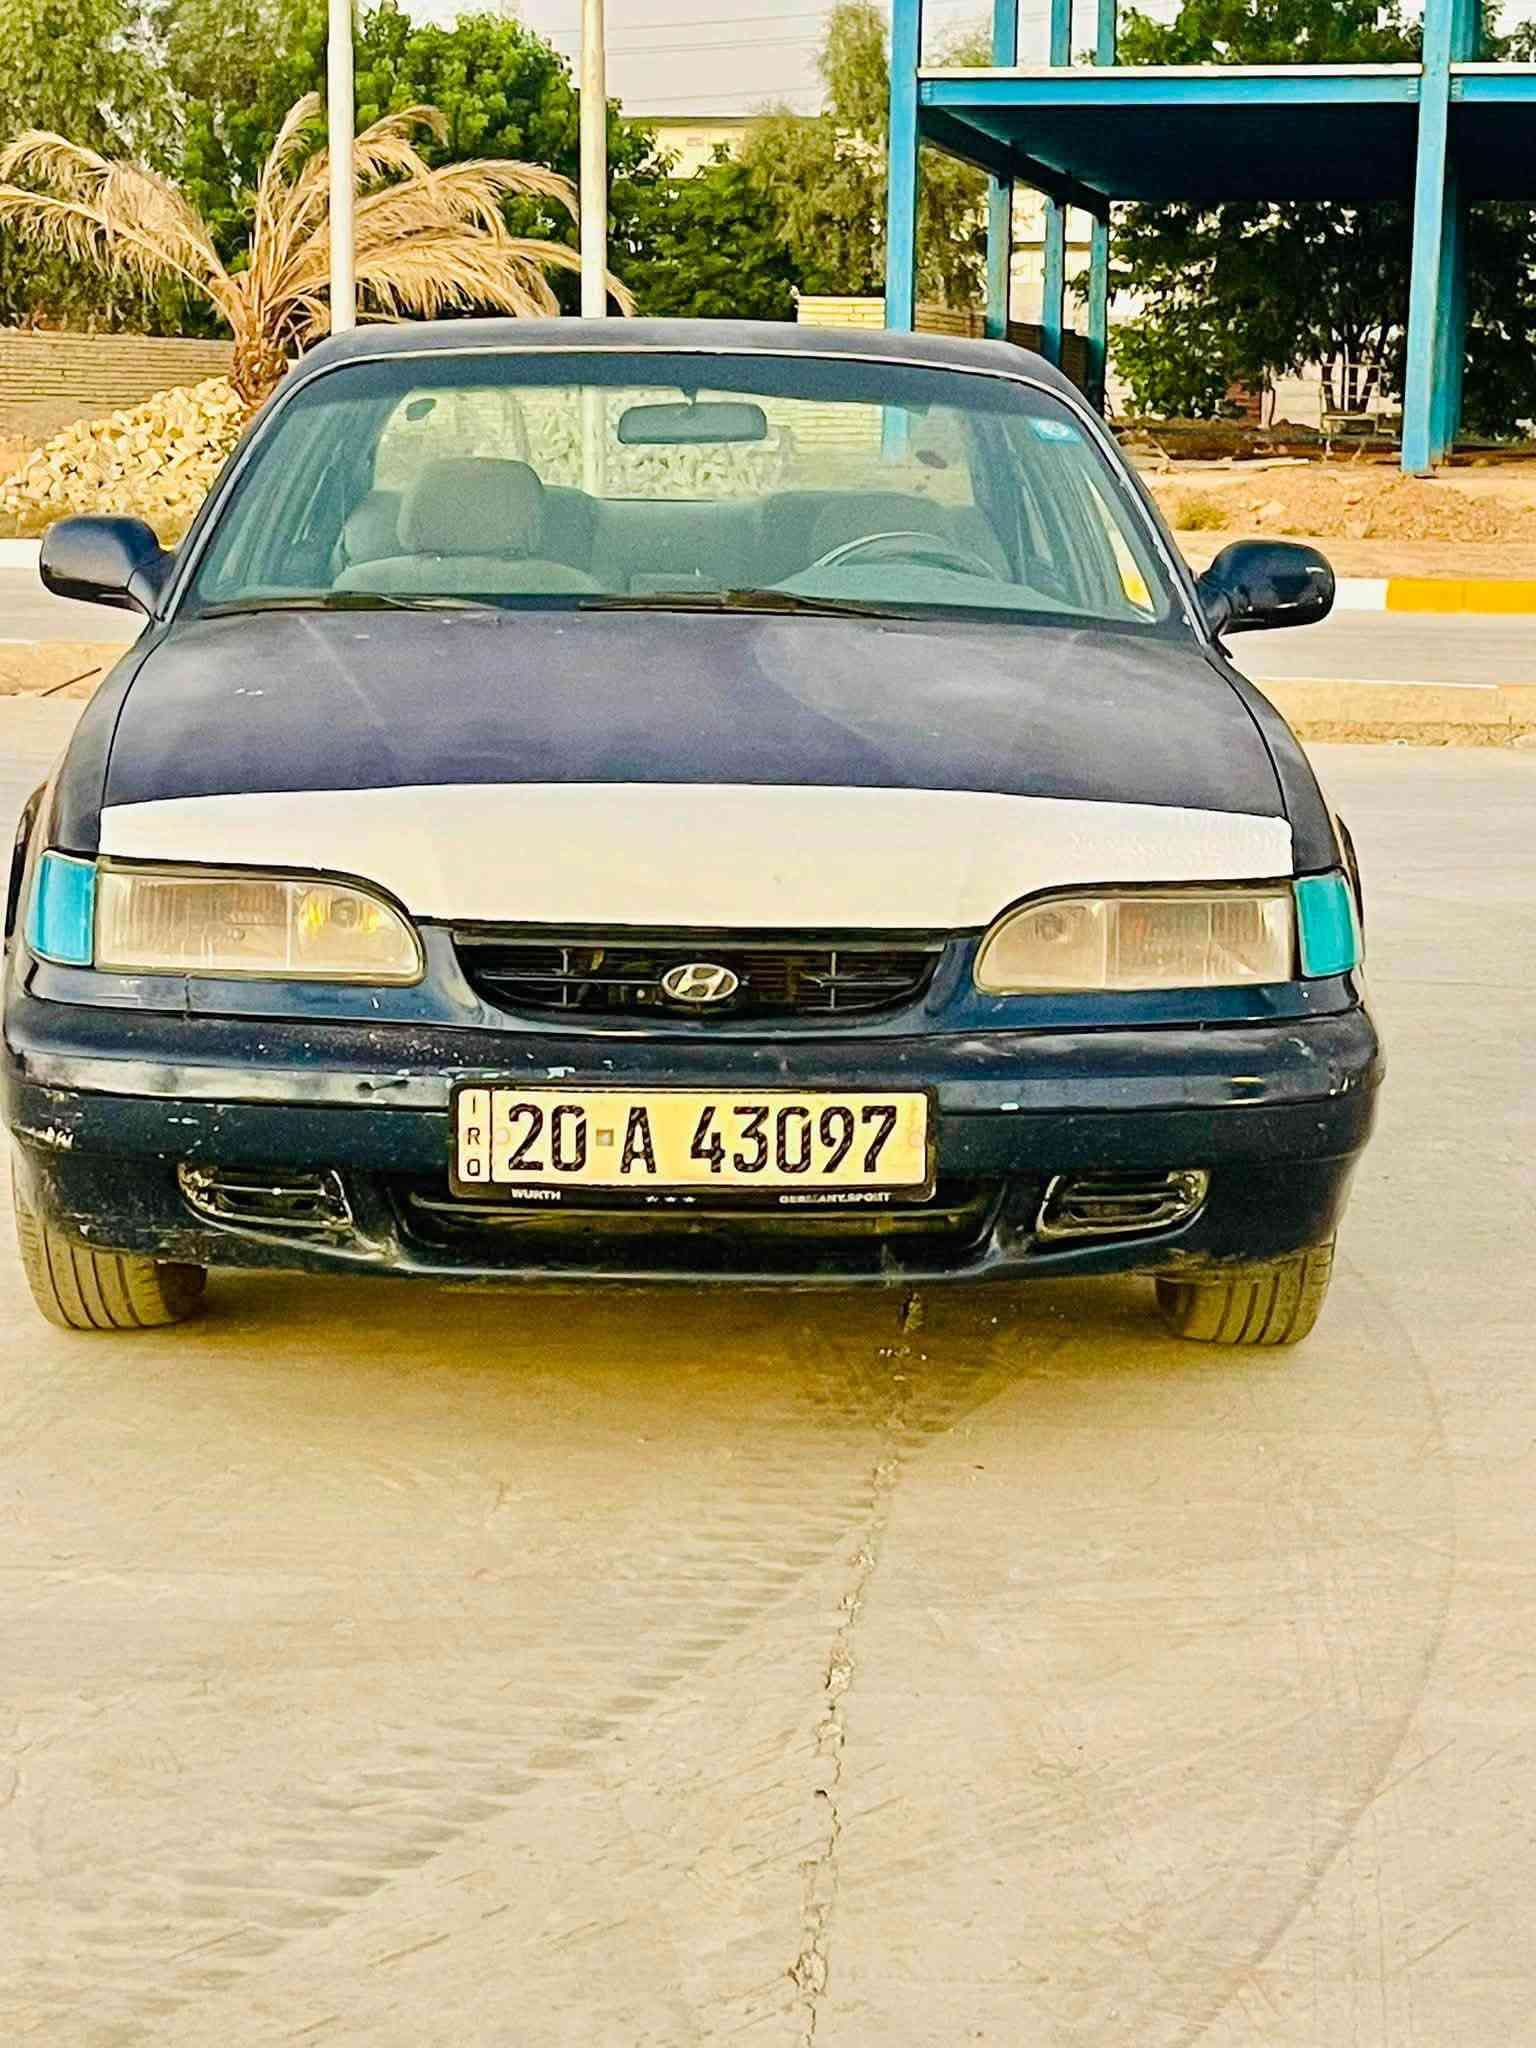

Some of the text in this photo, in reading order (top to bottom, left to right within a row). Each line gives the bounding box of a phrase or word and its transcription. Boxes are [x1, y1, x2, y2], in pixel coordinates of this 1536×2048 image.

[508, 1102, 897, 1174] 20 A 43097
